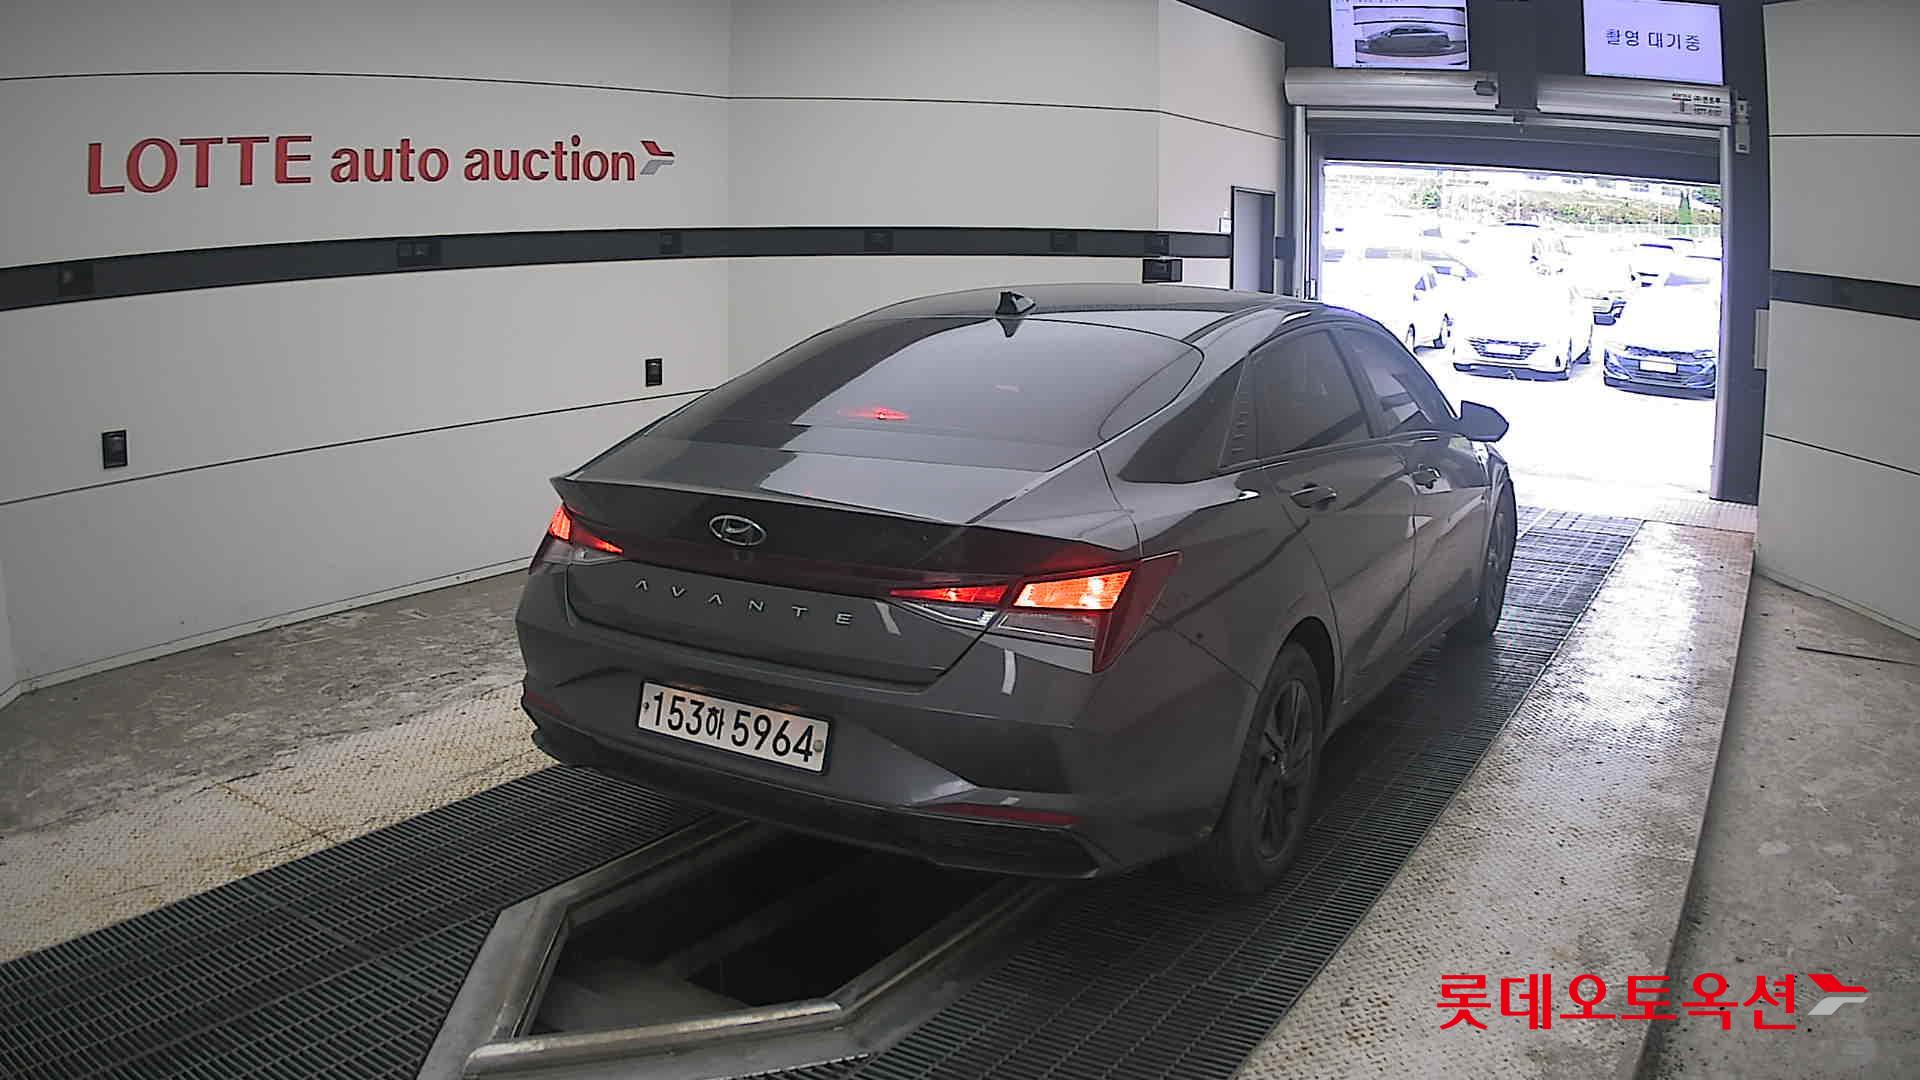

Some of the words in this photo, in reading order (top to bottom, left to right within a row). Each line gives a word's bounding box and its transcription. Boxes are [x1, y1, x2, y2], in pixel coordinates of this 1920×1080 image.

[88, 135, 312, 195] LOTTE
[330, 137, 449, 183] auto
[463, 134, 636, 182] auction
[635, 579, 853, 625] AVANTE
